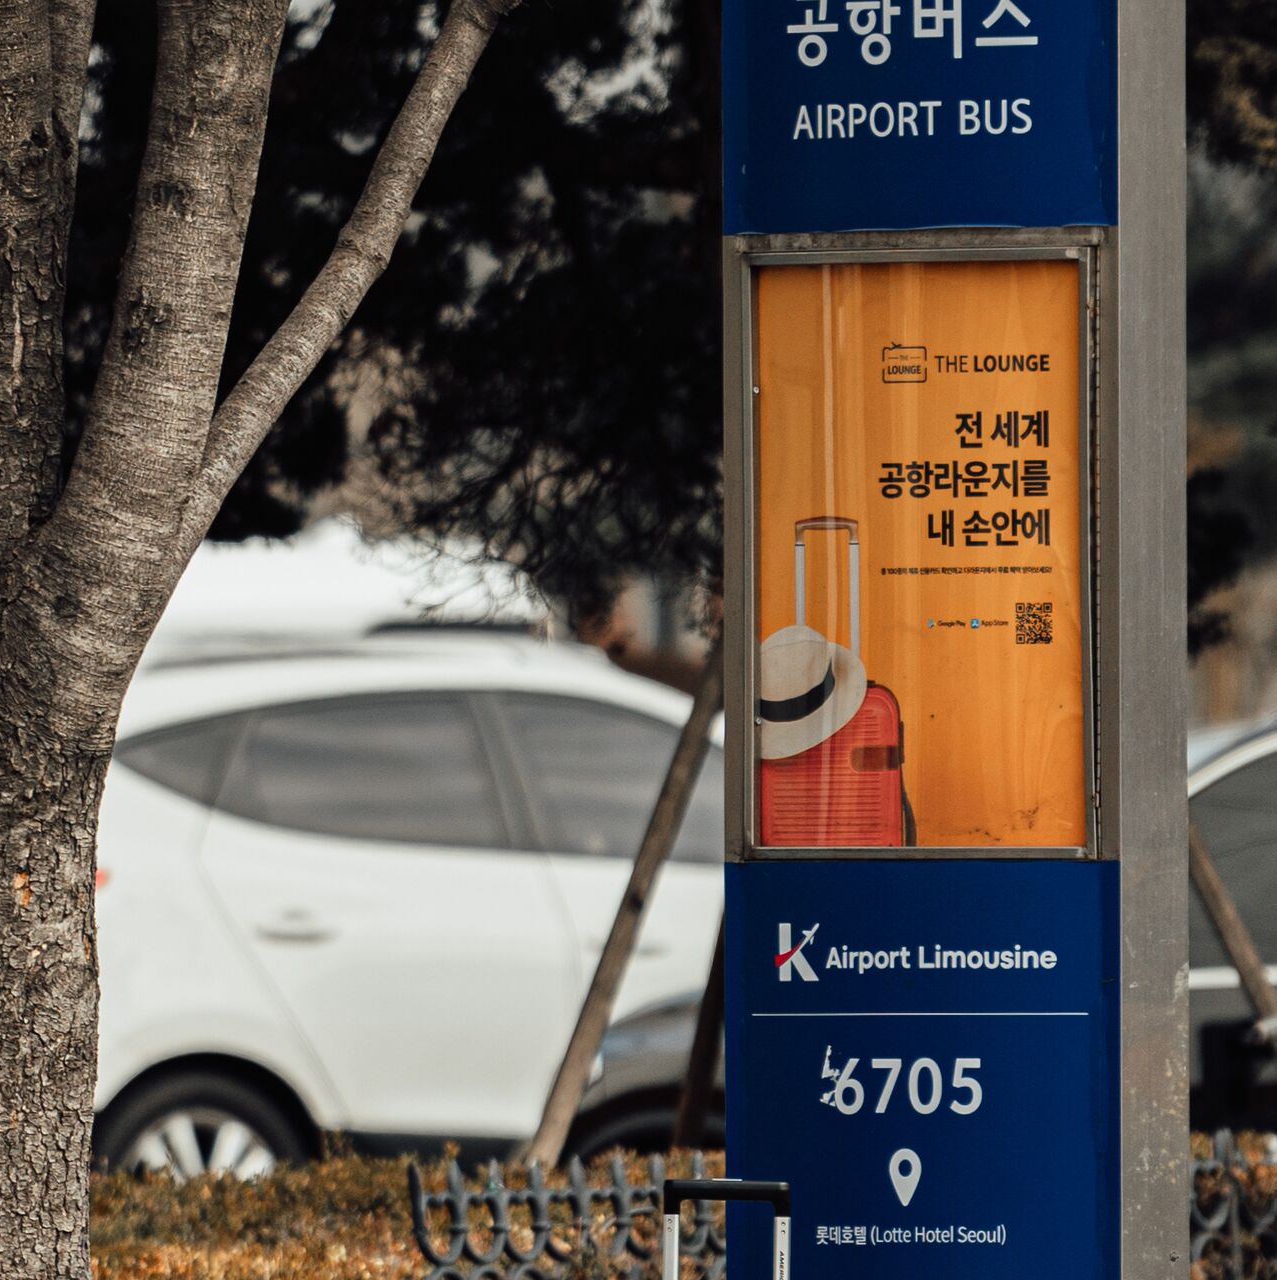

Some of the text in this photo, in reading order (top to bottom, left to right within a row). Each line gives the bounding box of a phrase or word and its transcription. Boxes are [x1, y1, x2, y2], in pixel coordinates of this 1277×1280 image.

[793, 98, 1032, 140] AIRPORT BUS
[887, 365, 922, 375] LOUNGE
[934, 354, 1050, 373] THE LOUNGE
[954, 410, 1049, 448] 전 세계
[878, 459, 1051, 499] 공항라운지를
[928, 509, 1051, 547] 내 손안에
[826, 946, 911, 974] Airport
[918, 944, 1058, 970] Limousine
[834, 1057, 983, 1116] 6705
[816, 1224, 1007, 1246] 롯데호텔 (Lotte Hotel Seoul)
